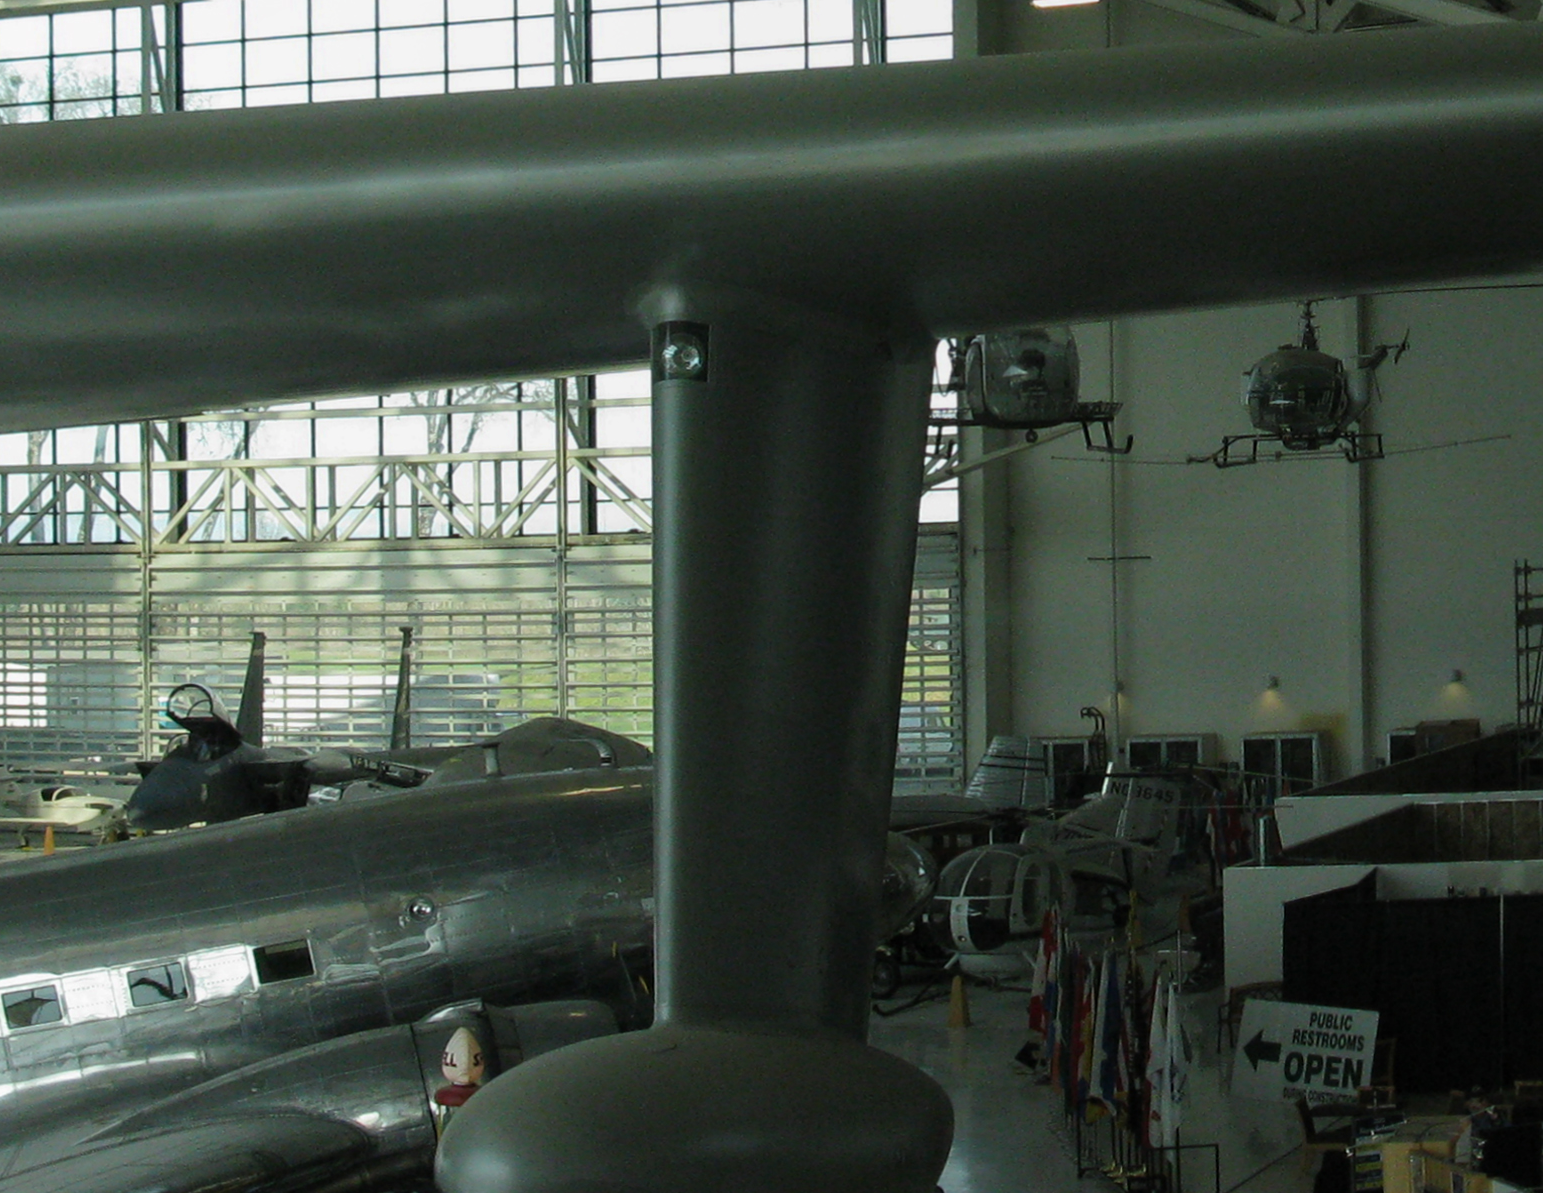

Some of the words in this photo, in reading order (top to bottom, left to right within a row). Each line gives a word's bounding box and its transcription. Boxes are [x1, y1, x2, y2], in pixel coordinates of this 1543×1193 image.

[1309, 1011, 1353, 1031] PUBLIC
[1292, 1028, 1364, 1052] RESTROOMS
[1283, 1051, 1364, 1088] OPEN
